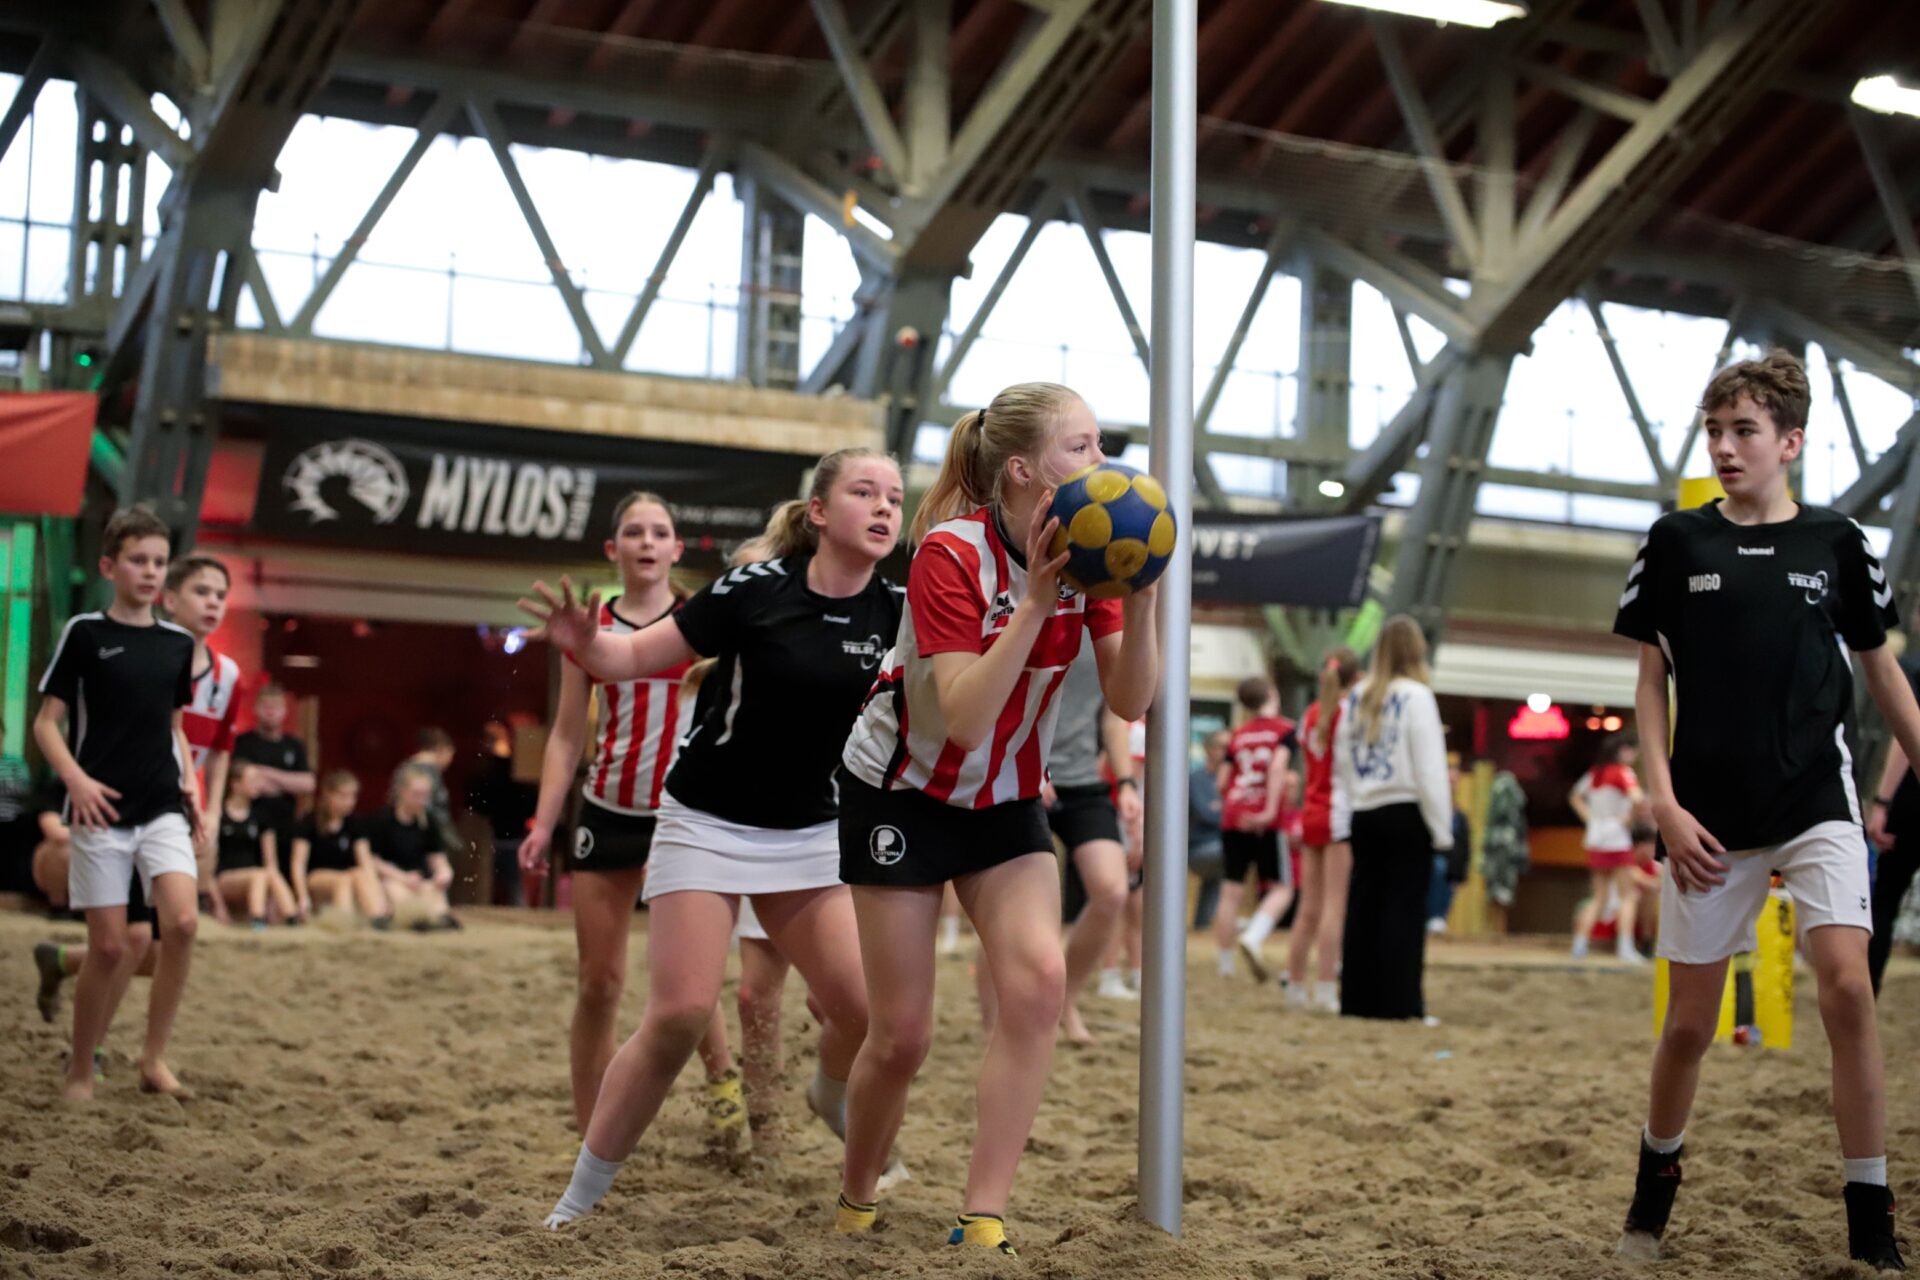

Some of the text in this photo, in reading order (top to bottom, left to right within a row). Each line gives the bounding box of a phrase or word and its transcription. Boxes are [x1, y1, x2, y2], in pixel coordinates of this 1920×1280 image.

[416, 453, 574, 539] MYLOS
[1737, 546, 1775, 556] hummel
[1688, 573, 1721, 593] HUGO
